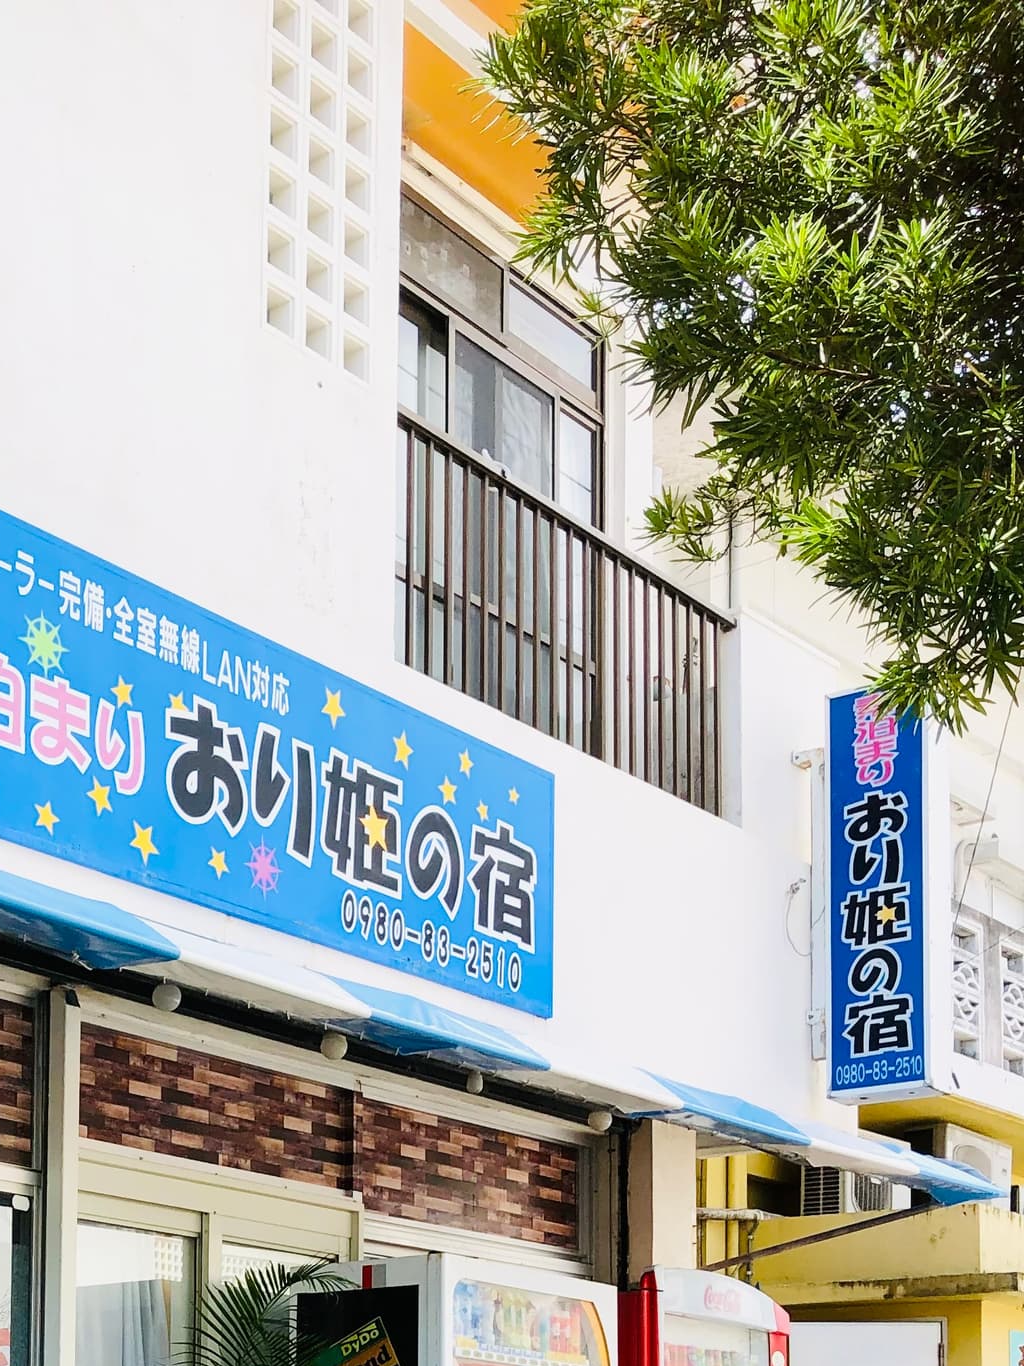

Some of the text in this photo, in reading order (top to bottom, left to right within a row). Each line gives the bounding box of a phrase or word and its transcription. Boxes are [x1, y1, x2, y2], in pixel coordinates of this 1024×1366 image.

[164, 692, 539, 956] おり姫の宿
[340, 887, 523, 994] 0980-83-2510
[842, 790, 914, 1059] おり姫の宿
[836, 1054, 924, 1086] 0980-83-2510
[340, 1323, 380, 1357] DyDo
